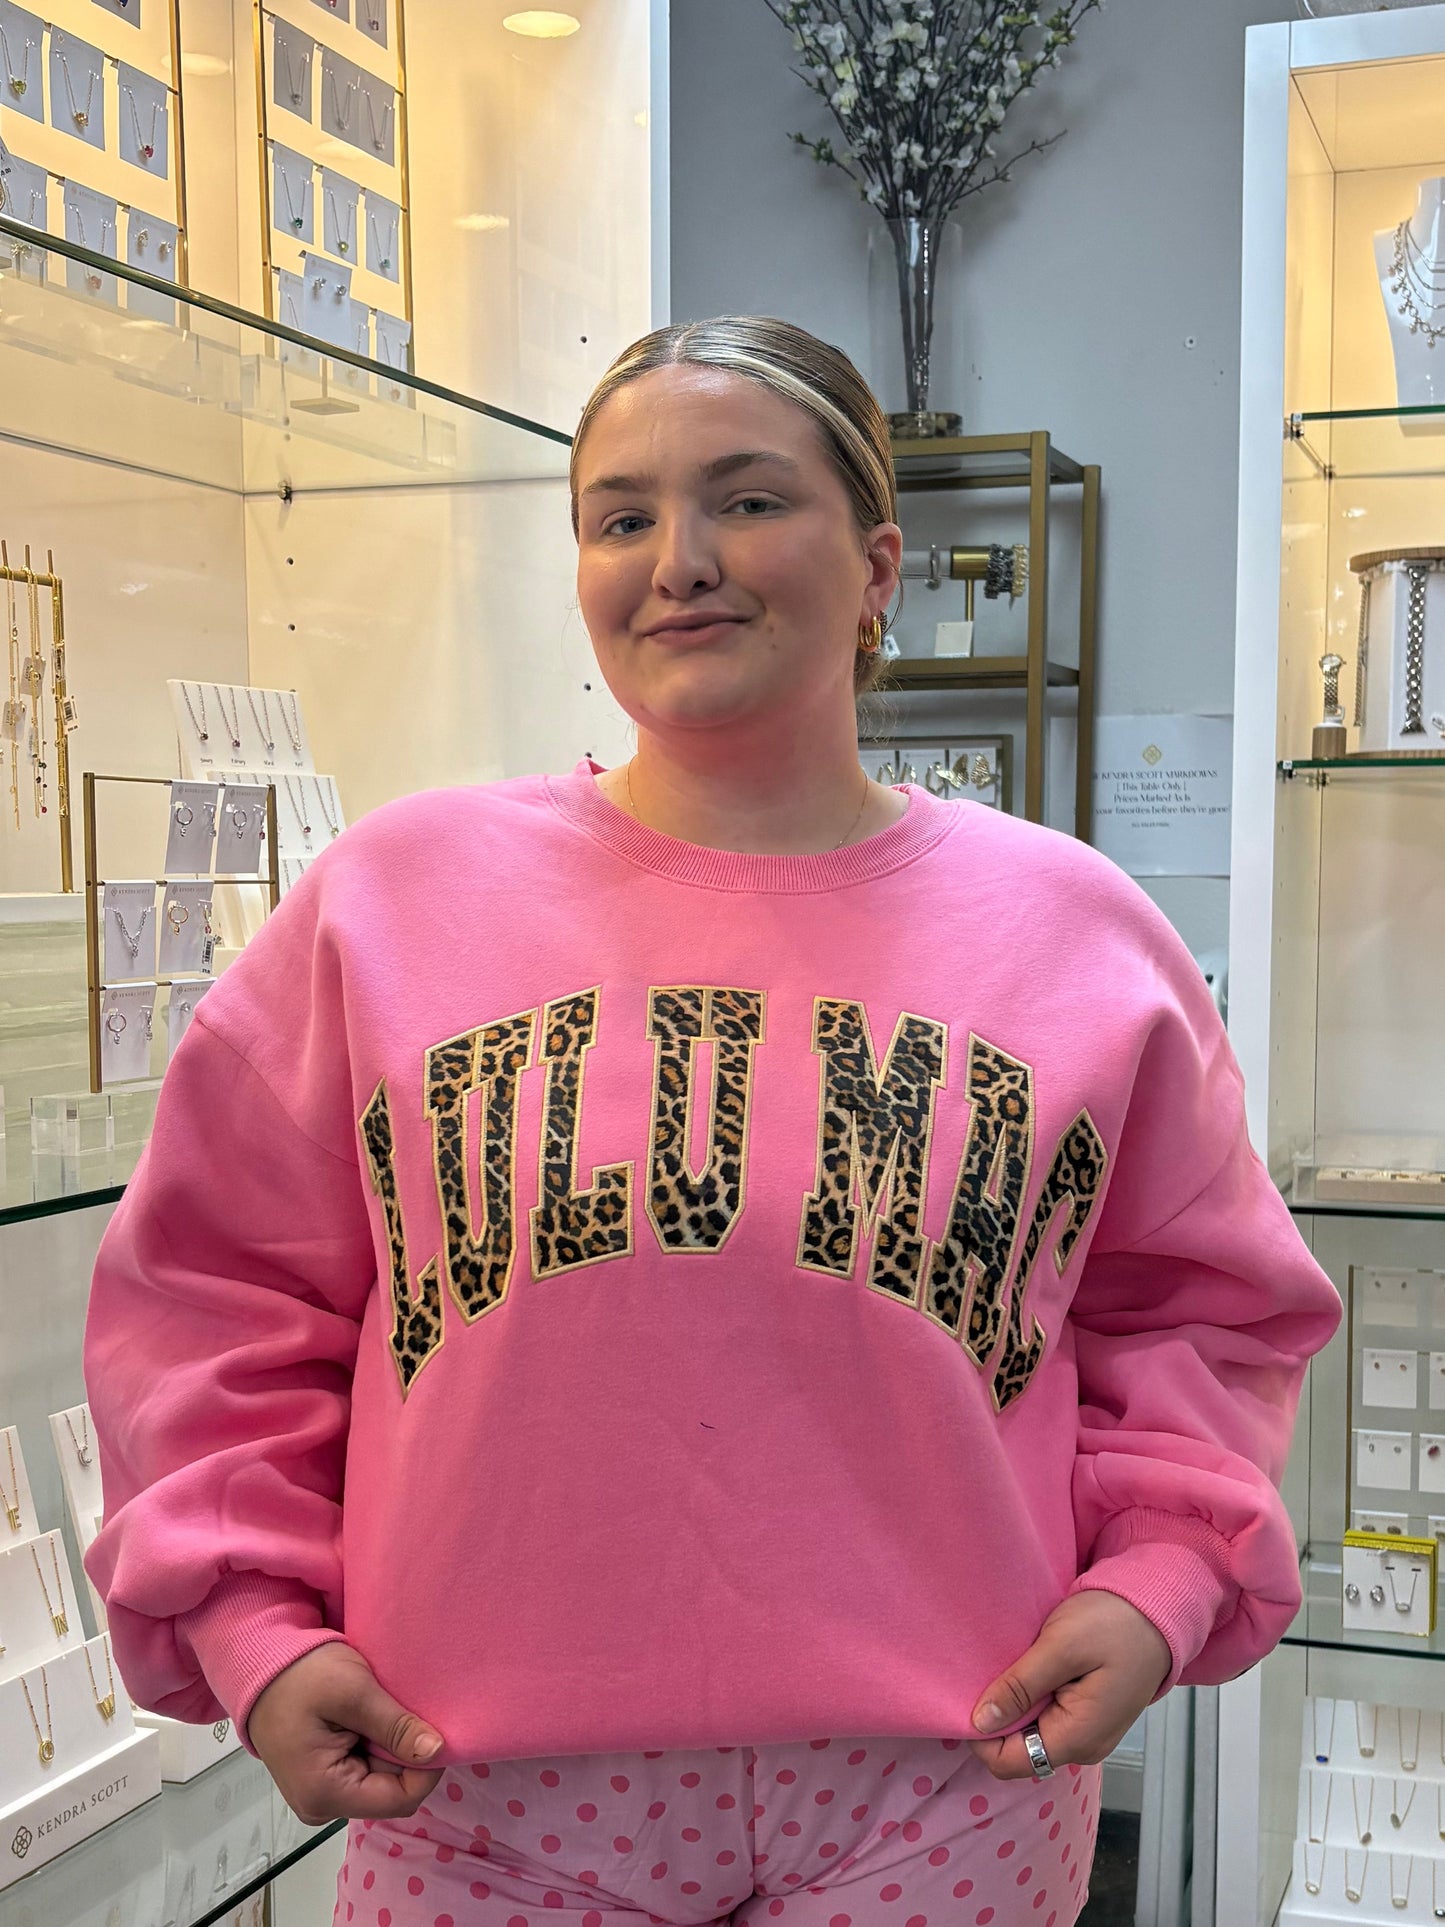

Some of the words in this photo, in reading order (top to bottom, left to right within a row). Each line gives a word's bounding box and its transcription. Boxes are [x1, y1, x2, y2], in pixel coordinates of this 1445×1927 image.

[1101, 771, 1134, 780] KENDRA
[1135, 770, 1163, 779] SCOTT
[1151, 804, 1178, 814] before
[36, 1800, 87, 1839] KENDRA
[91, 1775, 129, 1807] SCOTT
